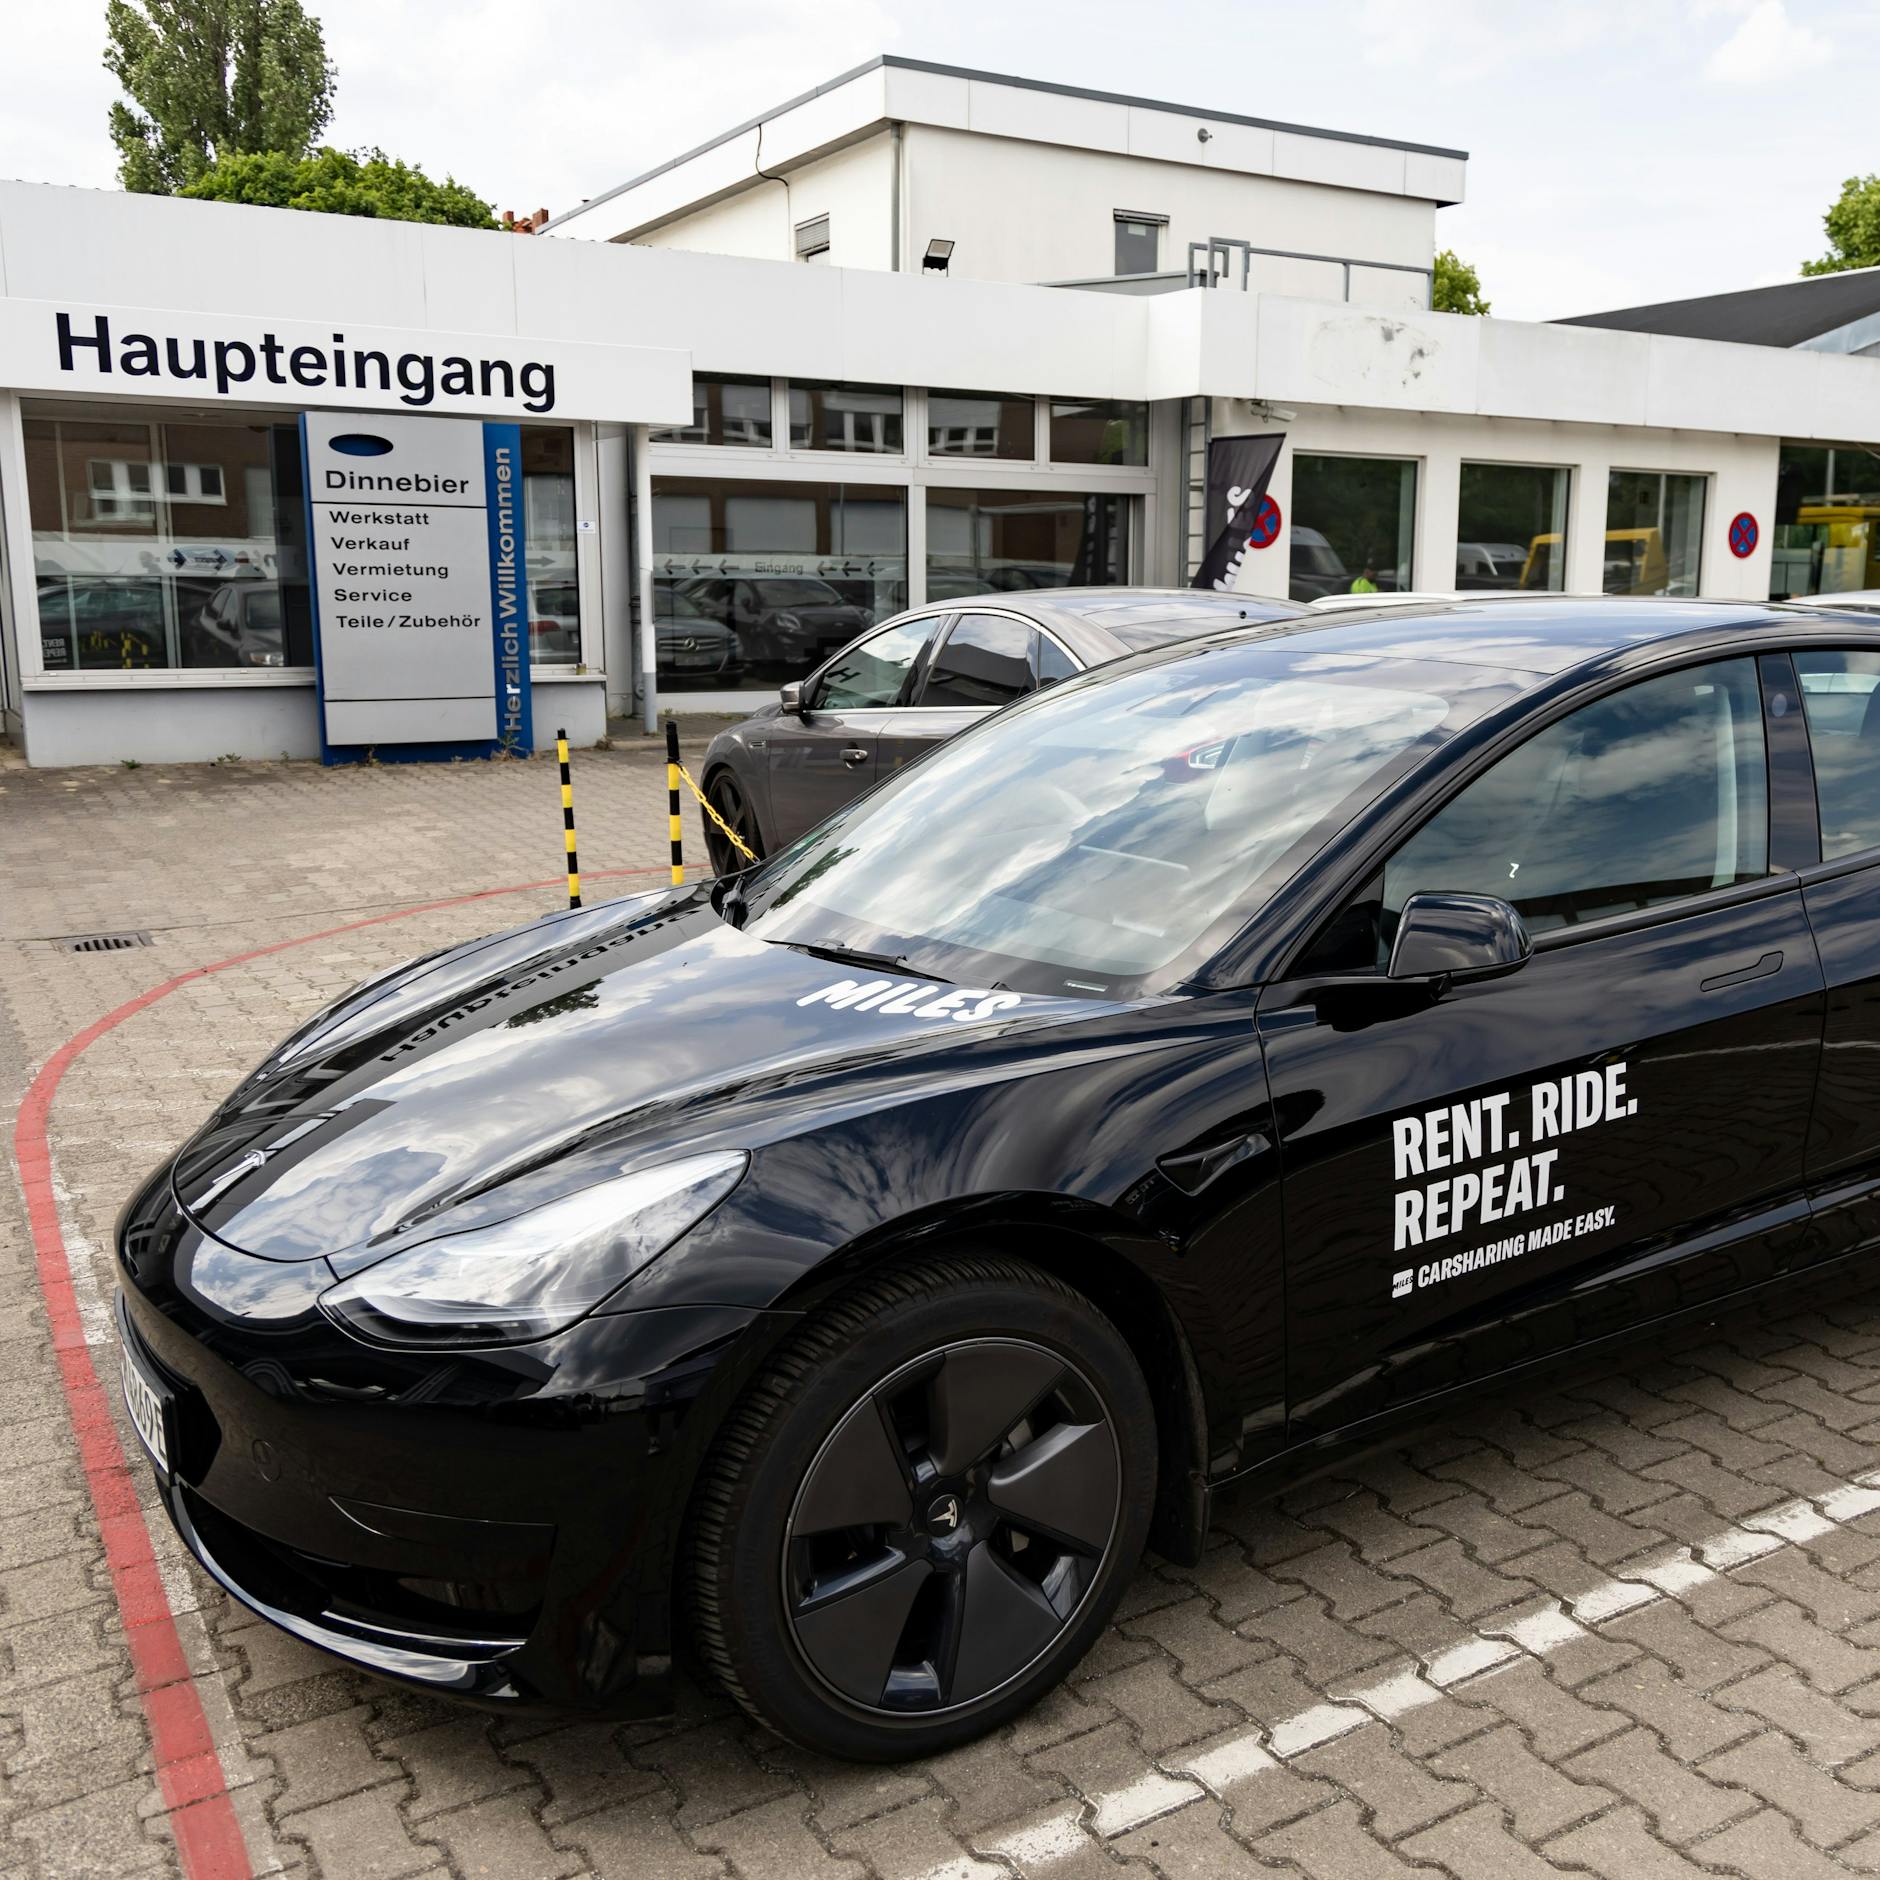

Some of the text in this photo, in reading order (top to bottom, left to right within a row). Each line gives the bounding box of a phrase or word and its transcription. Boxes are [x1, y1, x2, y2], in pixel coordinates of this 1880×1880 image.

[55, 312, 556, 413] Haupteingang
[325, 470, 469, 493] Dinnebier
[329, 510, 430, 525] Werkstatt
[331, 537, 410, 550] Verkauf
[332, 563, 449, 579] Vermietung
[754, 561, 803, 576] Eingang
[334, 588, 412, 601] Service
[496, 447, 523, 731] Herzlich Willkommen
[796, 979, 1022, 1022] MILES
[1393, 1062, 1638, 1180] RENT. RIDE.
[1394, 1148, 1565, 1251] REPEAT.
[1417, 1205, 1616, 1288] CARSHARING MADE EASY.
[1392, 1276, 1414, 1292] MILES
